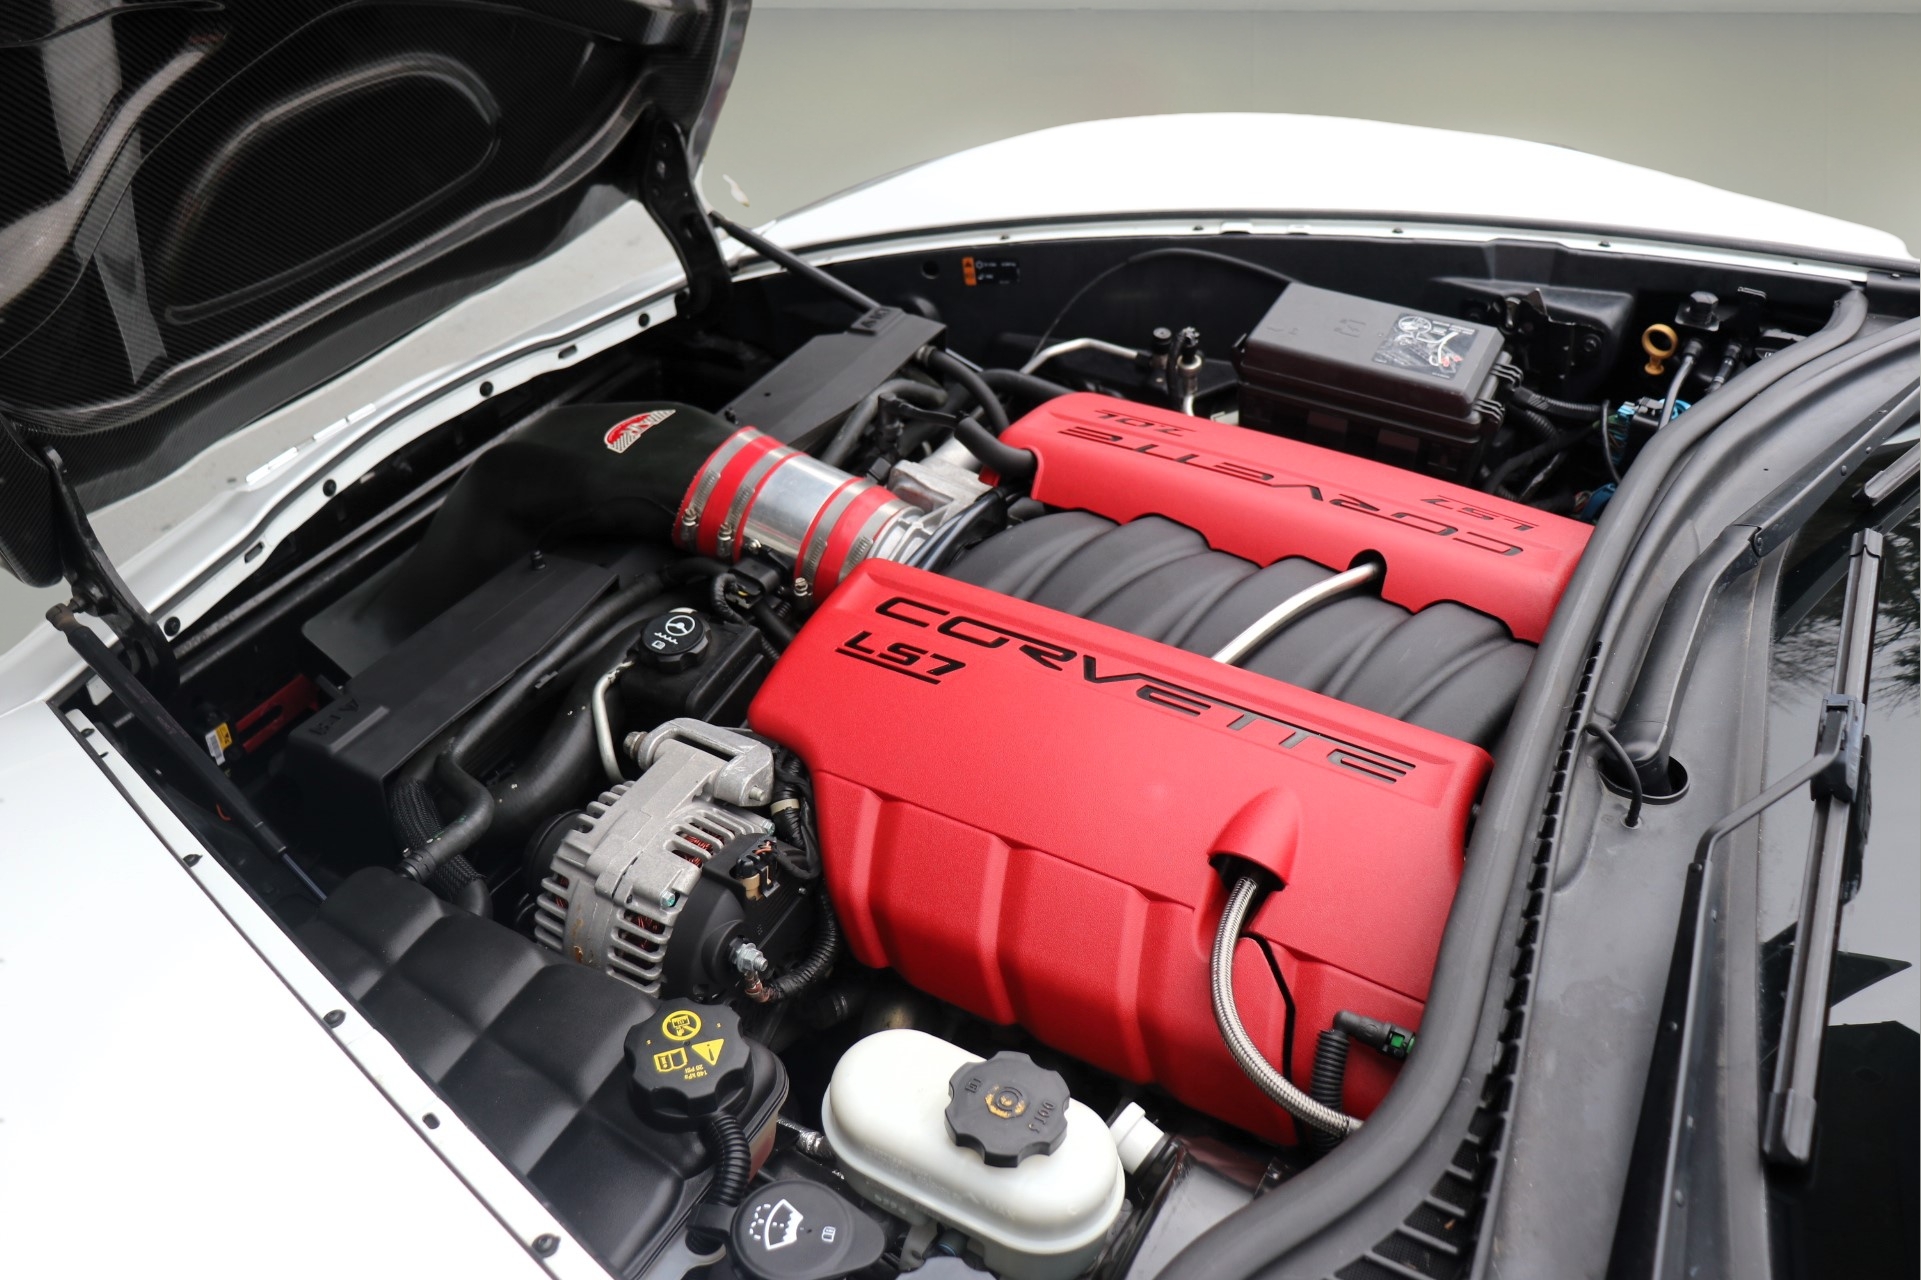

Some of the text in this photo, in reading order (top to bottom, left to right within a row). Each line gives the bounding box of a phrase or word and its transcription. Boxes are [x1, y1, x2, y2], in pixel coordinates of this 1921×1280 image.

[1059, 426, 1524, 556] CORVETTE
[1420, 498, 1535, 531] LS7
[842, 631, 966, 676] LS7
[874, 597, 1416, 784] CORVETTE
[1034, 1102, 1054, 1125] DOT
